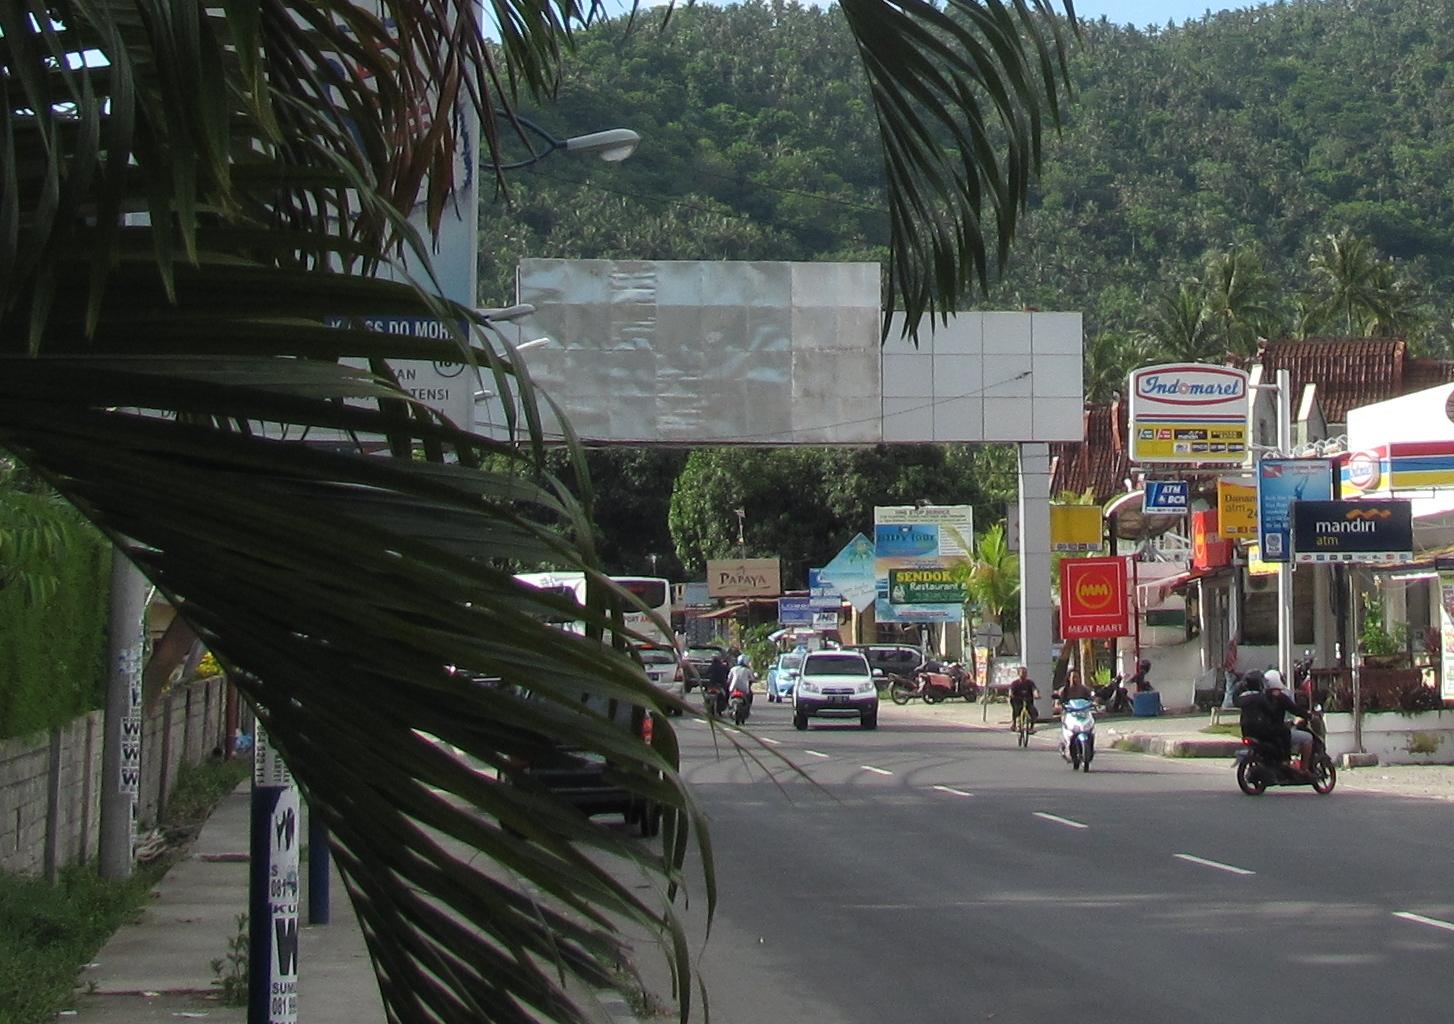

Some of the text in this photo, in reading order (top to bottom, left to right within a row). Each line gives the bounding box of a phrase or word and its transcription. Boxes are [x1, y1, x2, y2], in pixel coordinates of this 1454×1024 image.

[415, 321, 453, 339] MOR
[1142, 376, 1239, 395] Indomaret
[1162, 485, 1181, 494] ATM
[1316, 536, 1339, 546] atm
[719, 572, 767, 588] PAPAYA
[896, 571, 952, 582] SENDOK
[910, 582, 959, 591] Restaurant
[1068, 624, 1123, 633] MEAT MART
